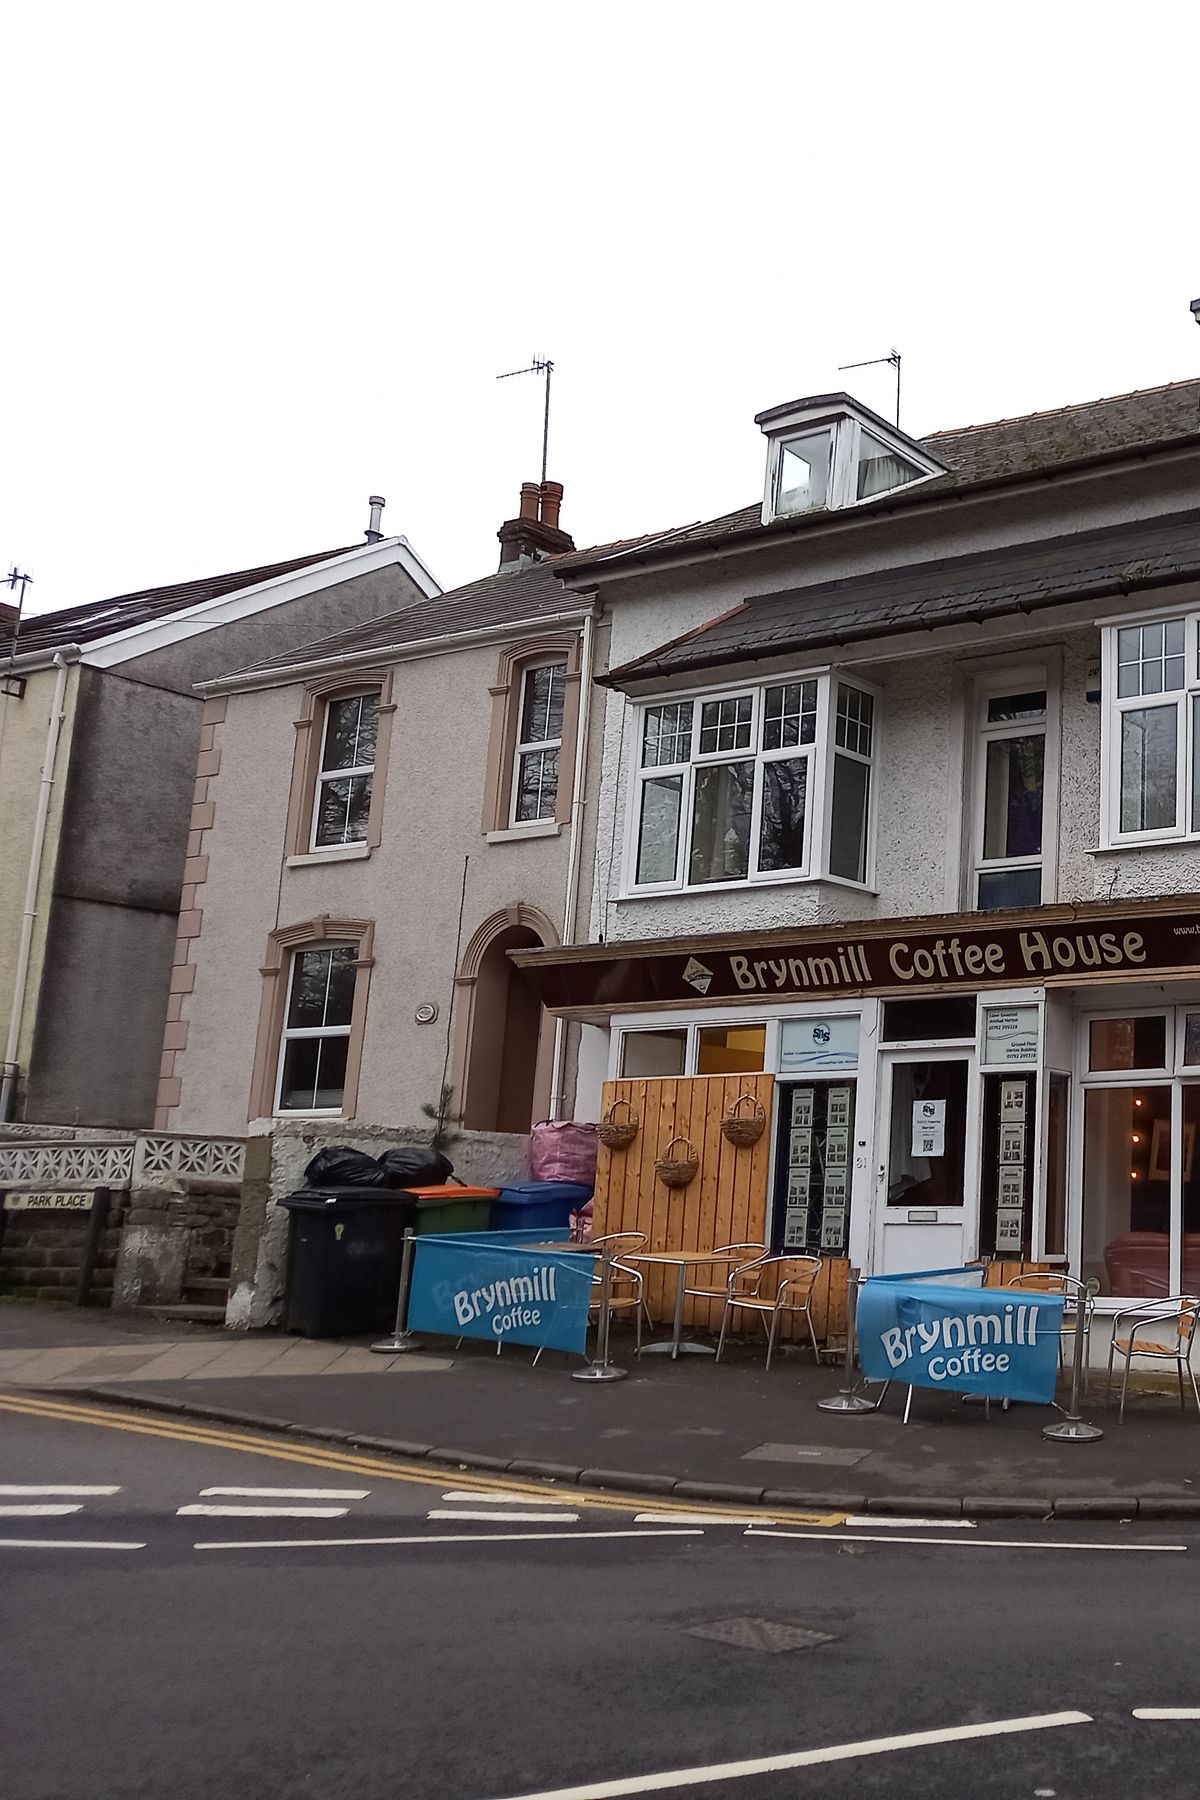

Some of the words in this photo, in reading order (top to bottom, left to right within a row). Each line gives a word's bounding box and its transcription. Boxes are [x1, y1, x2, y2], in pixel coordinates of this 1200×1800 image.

[729, 944, 872, 990] Brynmill
[889, 937, 1006, 980] Coffee
[1018, 931, 1147, 972] House
[27, 1195, 52, 1207] PARK
[54, 1194, 87, 1207] PLACE
[453, 1266, 557, 1326] Brynmill
[492, 1306, 542, 1336] Coffee
[880, 1304, 1039, 1369] Brynmill
[928, 1348, 1010, 1381] Coffee
